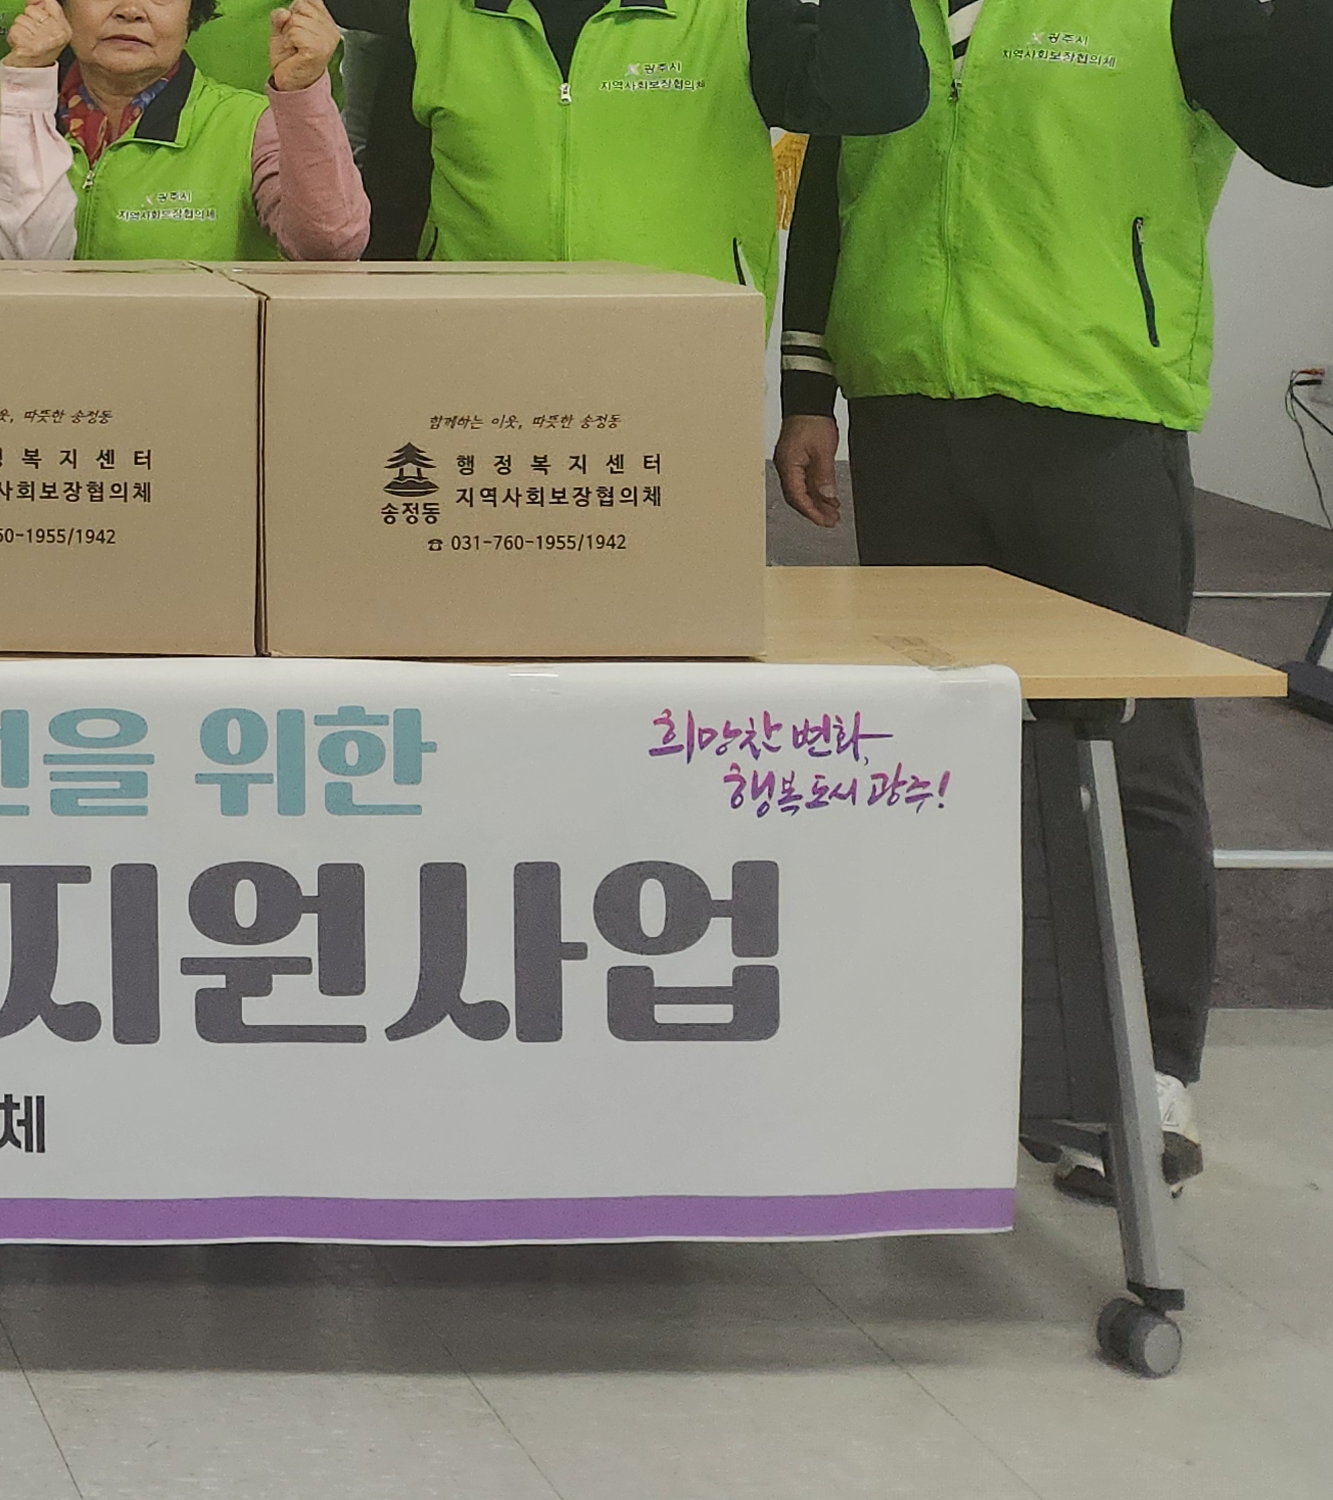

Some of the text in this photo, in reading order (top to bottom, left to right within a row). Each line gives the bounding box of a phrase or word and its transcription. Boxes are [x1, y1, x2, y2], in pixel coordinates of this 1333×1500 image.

[23, 409, 66, 424] 따뜻한
[70, 409, 114, 425] 송정동
[429, 415, 484, 430] 함께하는
[532, 414, 574, 429] 따뜻한
[580, 414, 623, 430] 송정동
[455, 485, 662, 508] 지역사회보장협의체
[381, 502, 440, 525] 송정동
[451, 534, 627, 552] 031-760-1955/1942
[649, 708, 783, 764] 희망찬
[194, 705, 438, 818] 위한
[866, 761, 951, 814] 광주!
